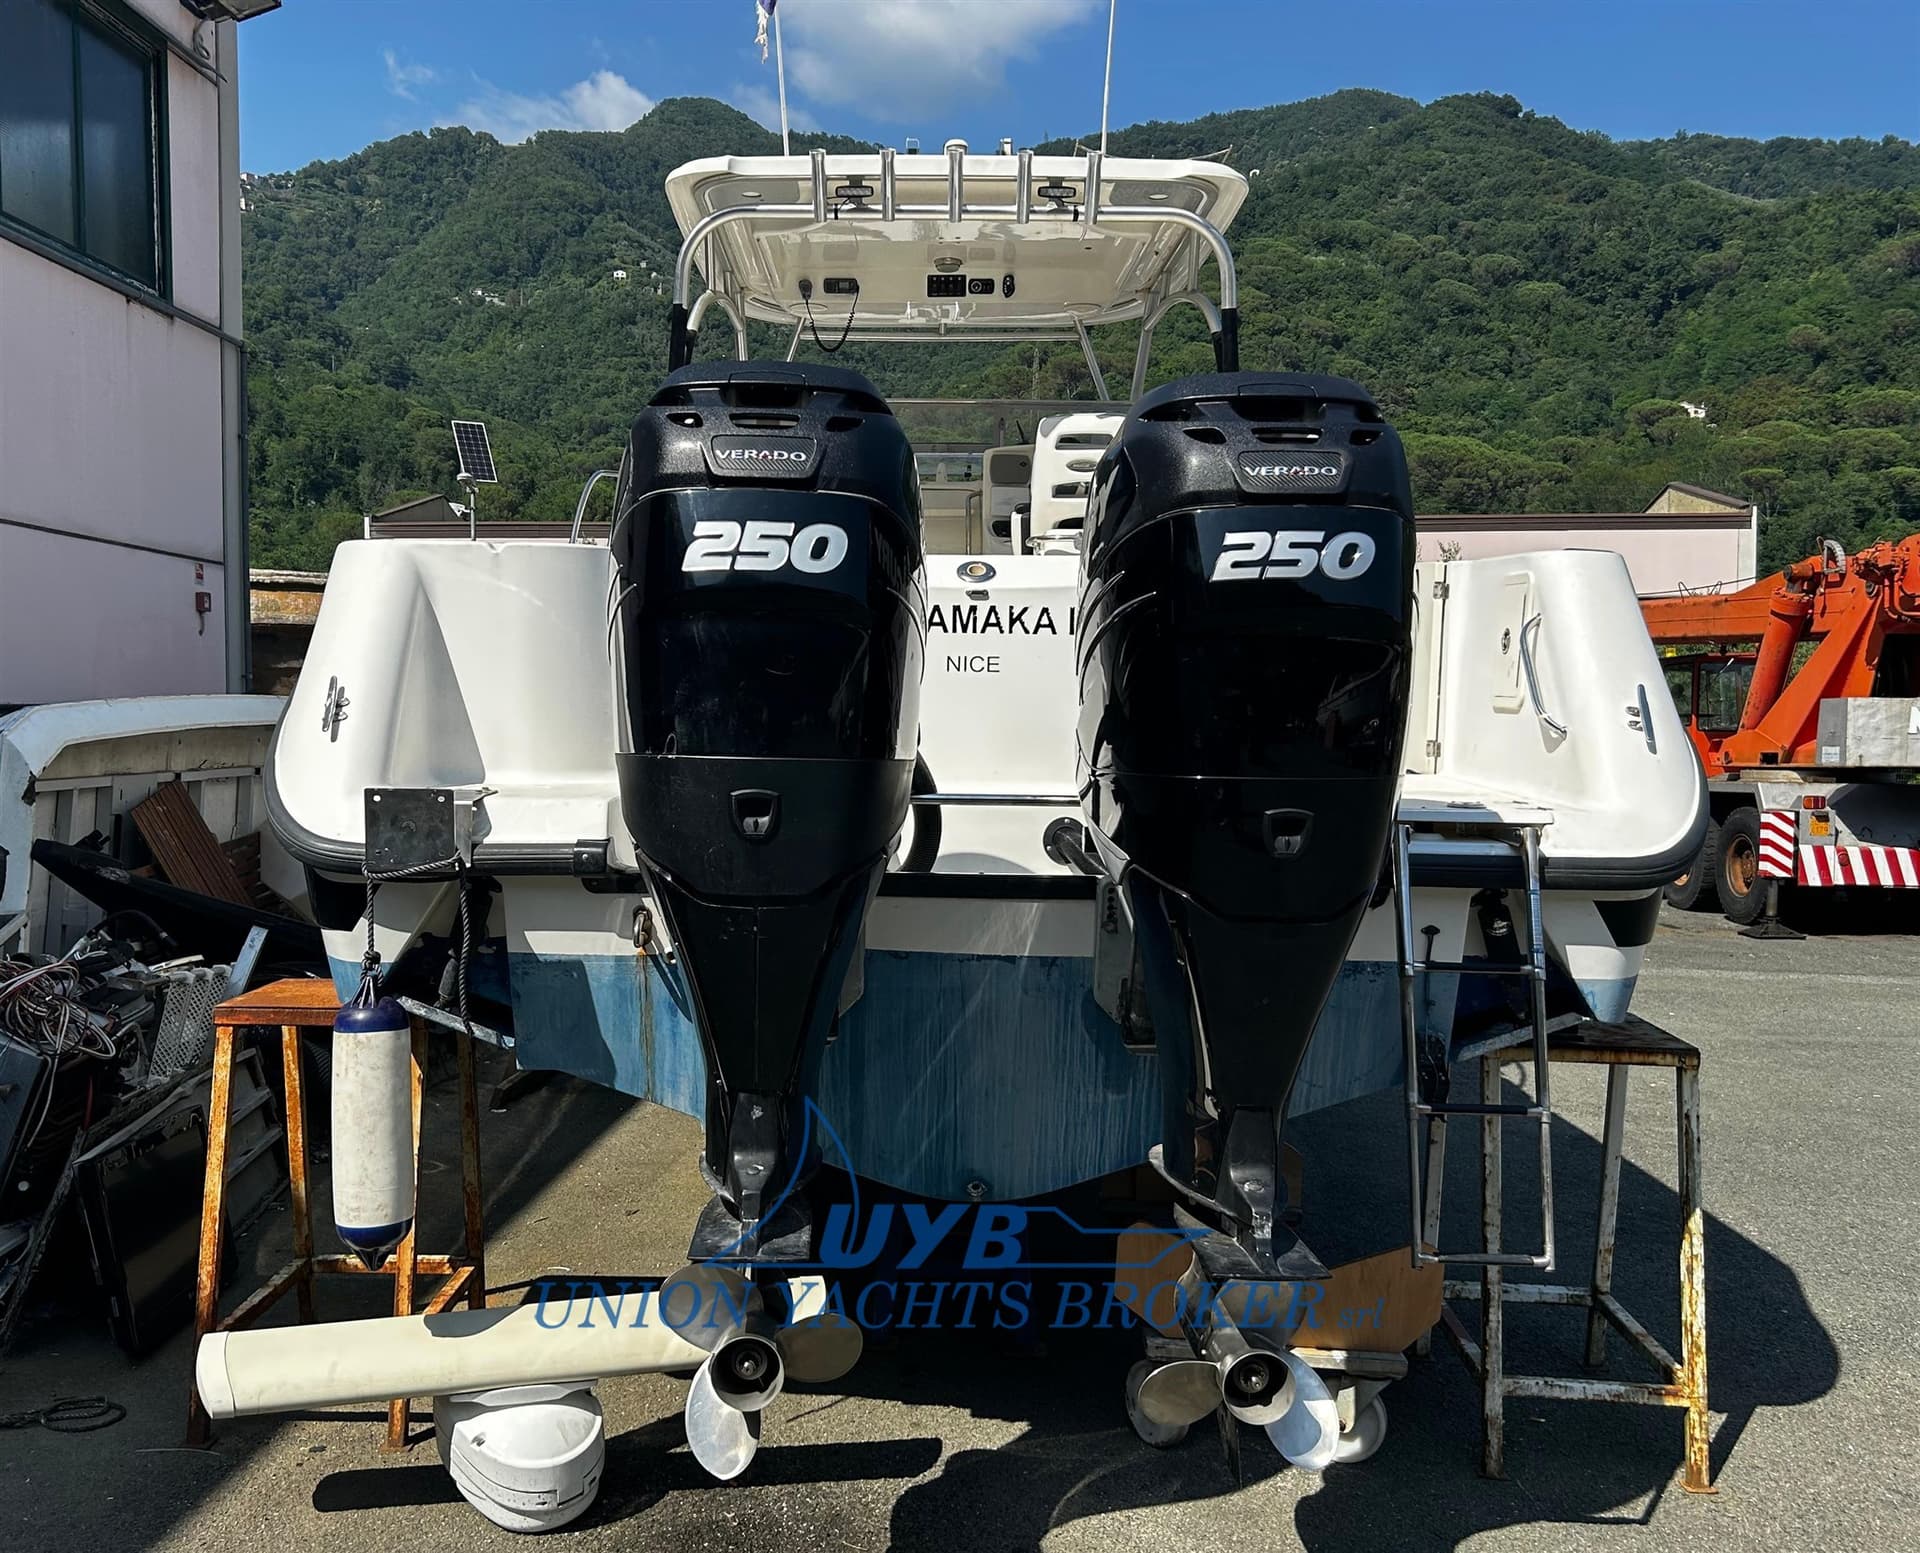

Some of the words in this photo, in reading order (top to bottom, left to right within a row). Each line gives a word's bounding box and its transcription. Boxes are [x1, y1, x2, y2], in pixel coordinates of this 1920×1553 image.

[714, 447, 808, 463] VERADO
[1242, 464, 1339, 478] VERADO
[681, 520, 849, 574] 250
[1209, 530, 1377, 582] 250
[946, 655, 1001, 673] NICE
